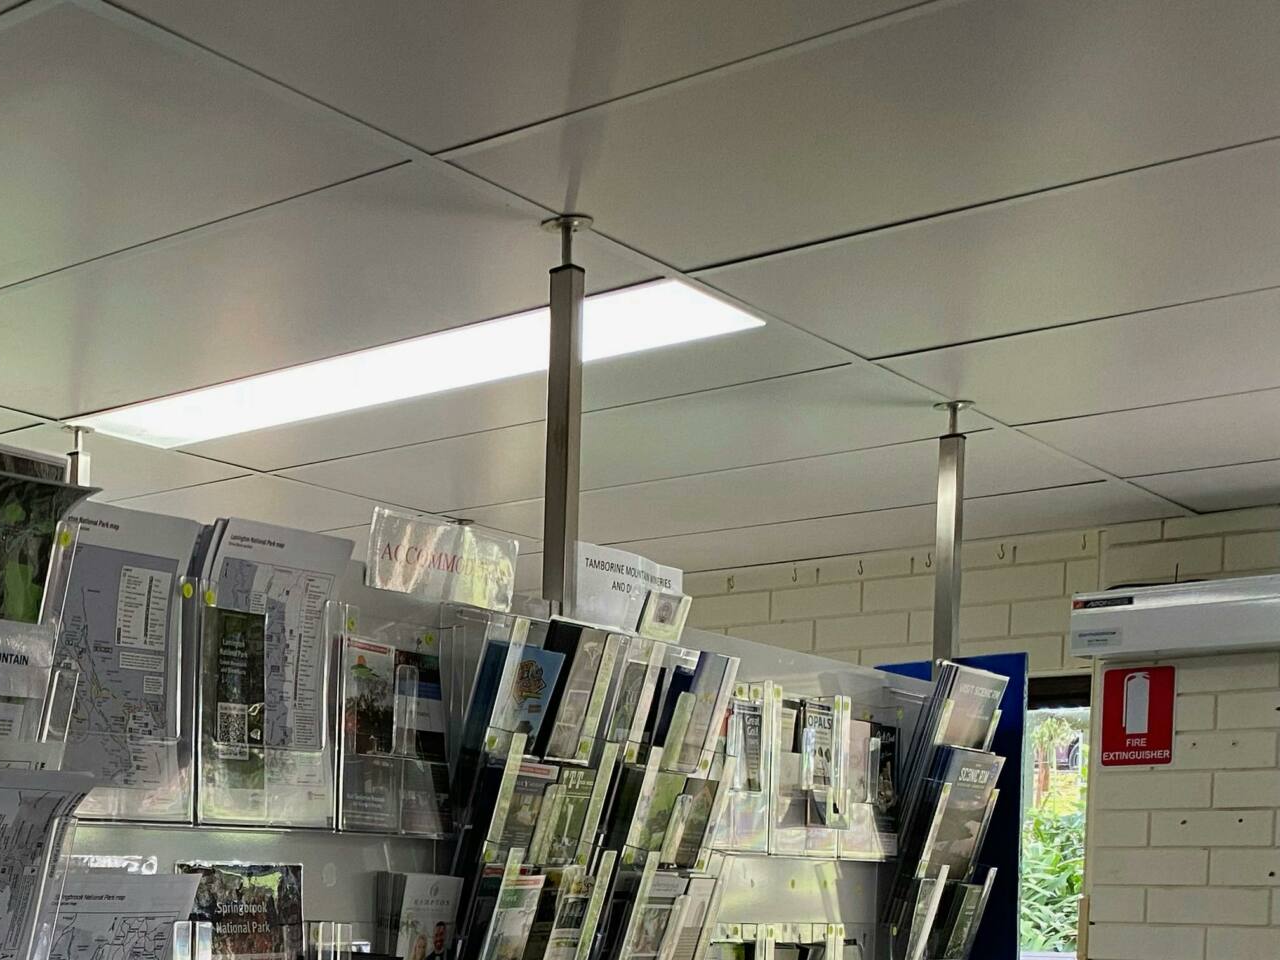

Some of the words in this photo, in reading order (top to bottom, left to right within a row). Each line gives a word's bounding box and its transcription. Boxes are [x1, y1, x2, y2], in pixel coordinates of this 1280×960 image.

[380, 541, 511, 580] ACCOMMOD
[585, 557, 625, 575] TAMBORINE
[625, 565, 650, 582] MOUNTAIN
[611, 580, 626, 593] AND
[807, 714, 832, 730] OPALS
[1125, 737, 1147, 747] FIRE
[1102, 749, 1171, 761] EXTINGUISHER
[215, 901, 268, 916] Springbrook
[215, 921, 251, 935] National
[252, 921, 271, 933] Park
